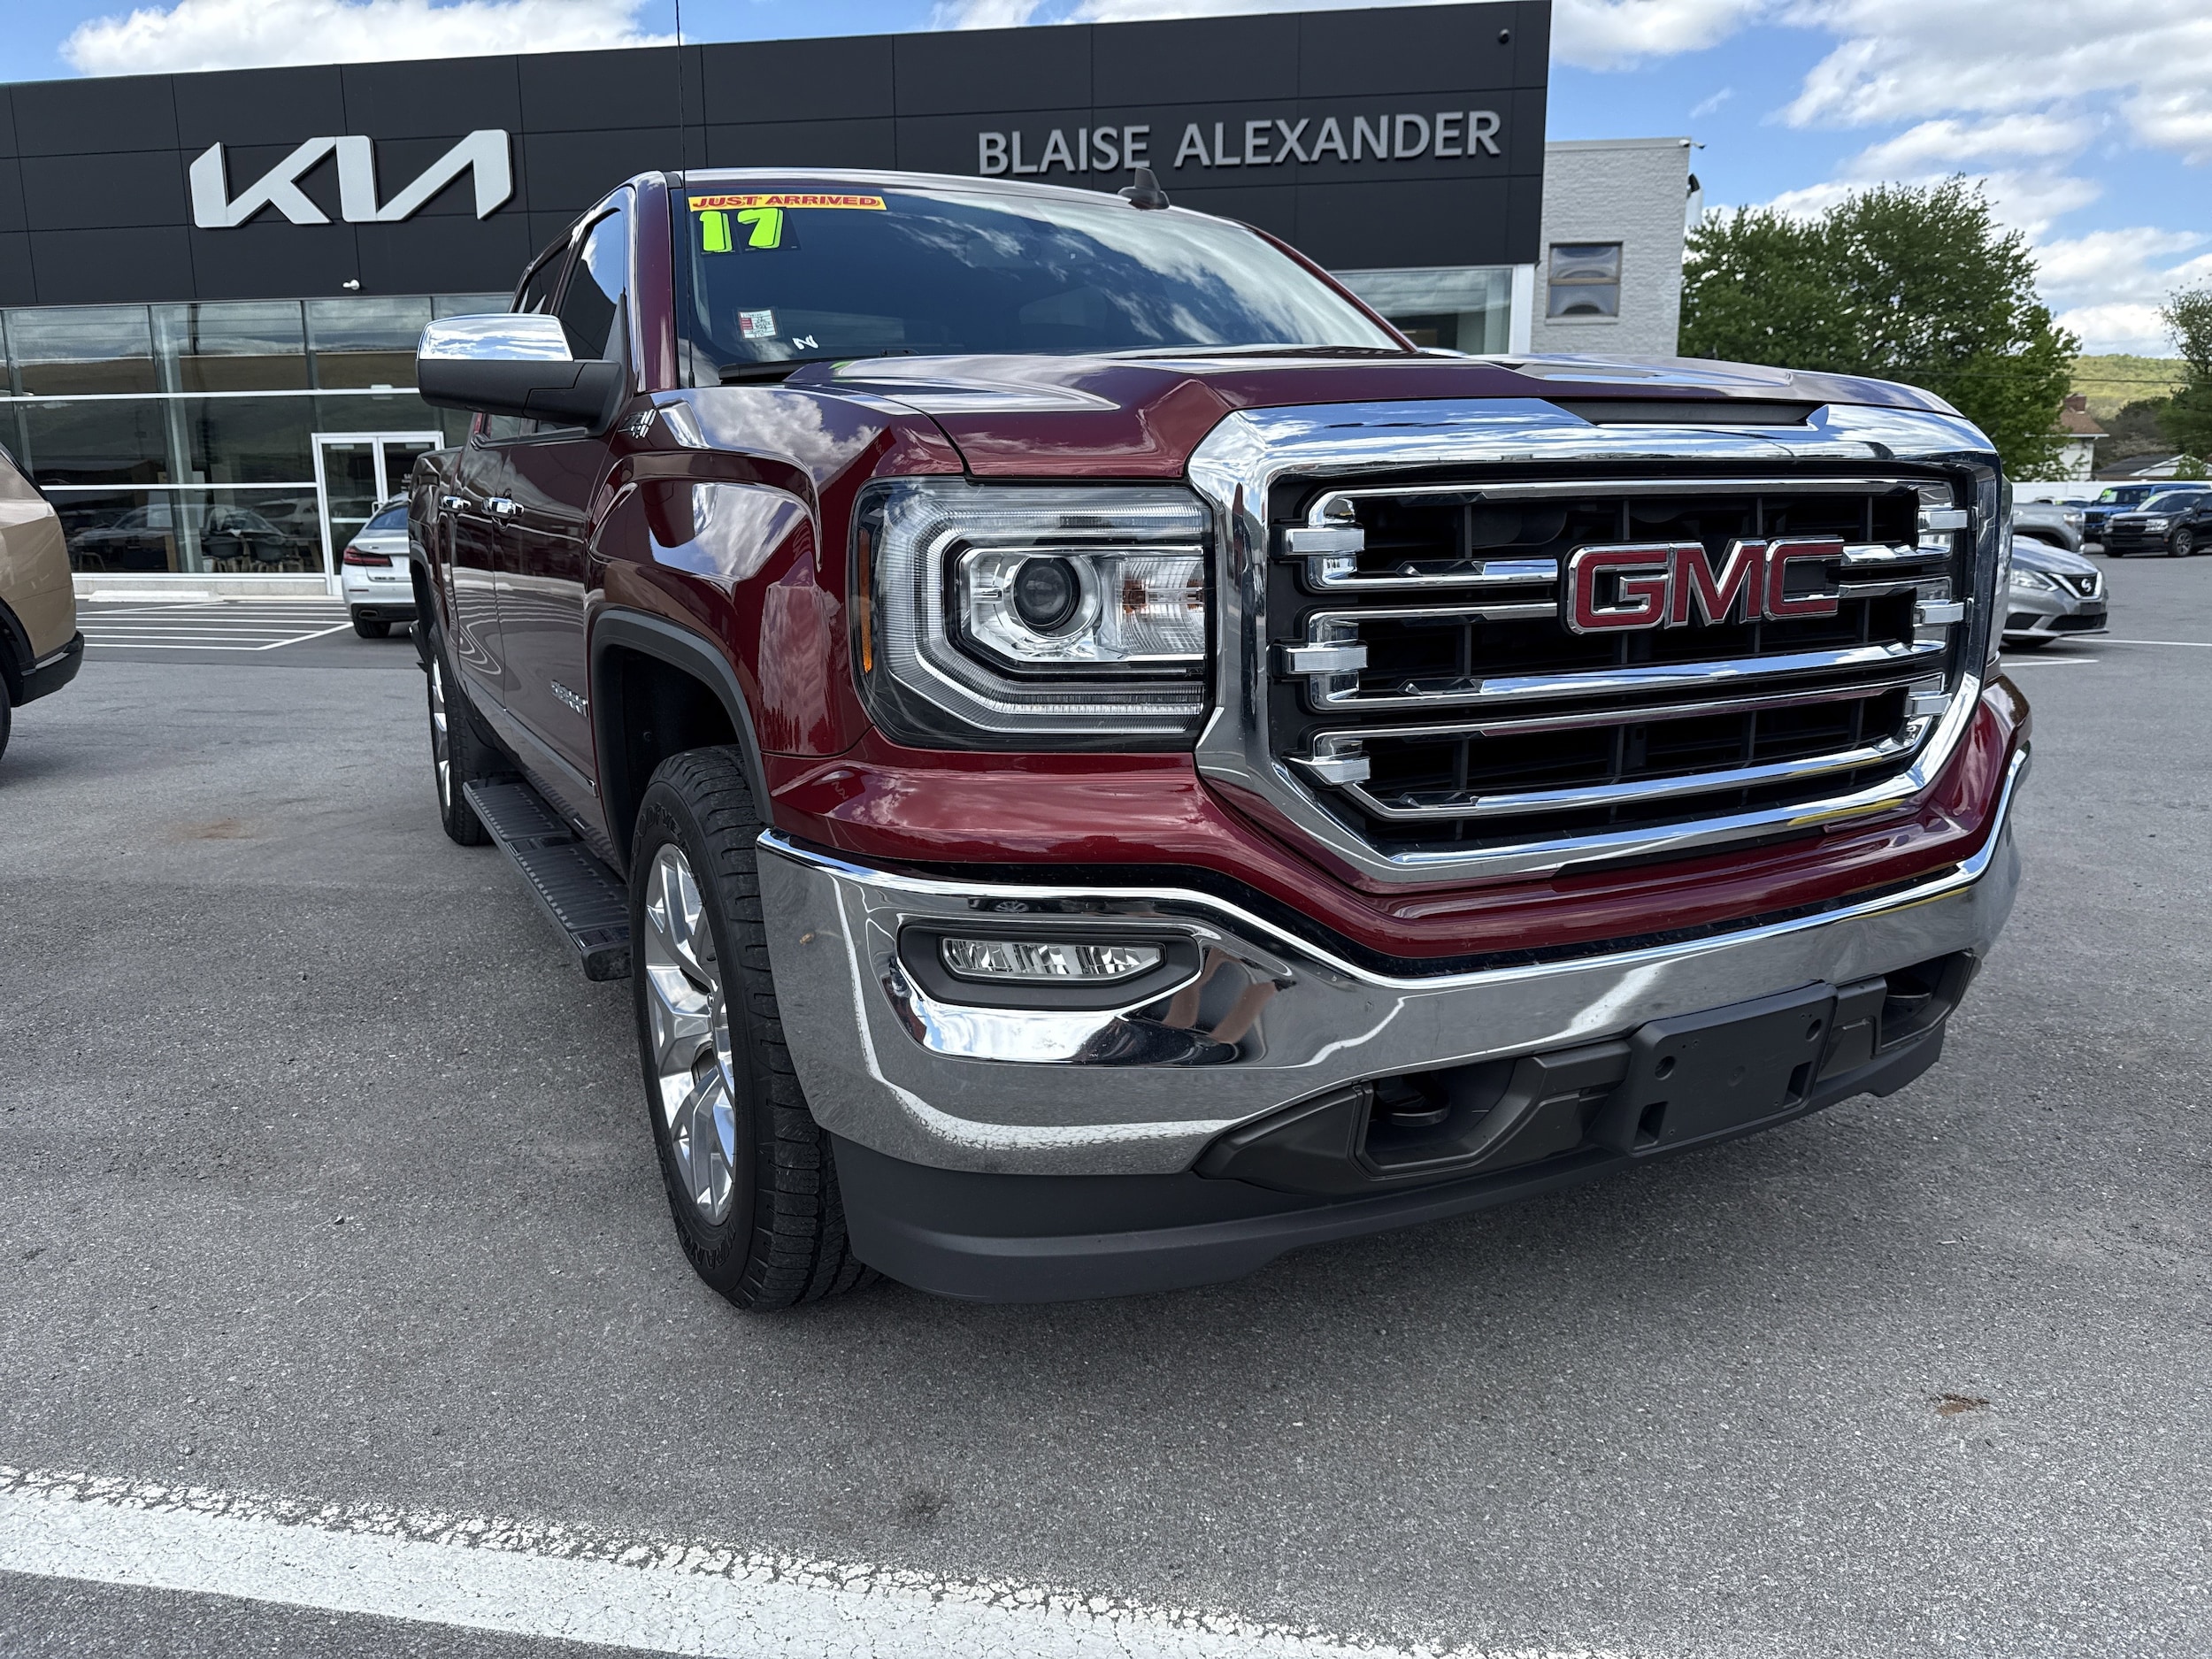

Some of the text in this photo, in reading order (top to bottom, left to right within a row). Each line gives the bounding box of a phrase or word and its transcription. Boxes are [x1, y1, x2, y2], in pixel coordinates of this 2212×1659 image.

[979, 110, 1502, 174] BLAISE ALEXANDER
[188, 128, 512, 228] KIA
[693, 196, 880, 208] JUST ARRIVED
[699, 208, 784, 253] 17
[1567, 538, 1845, 634] GMC
